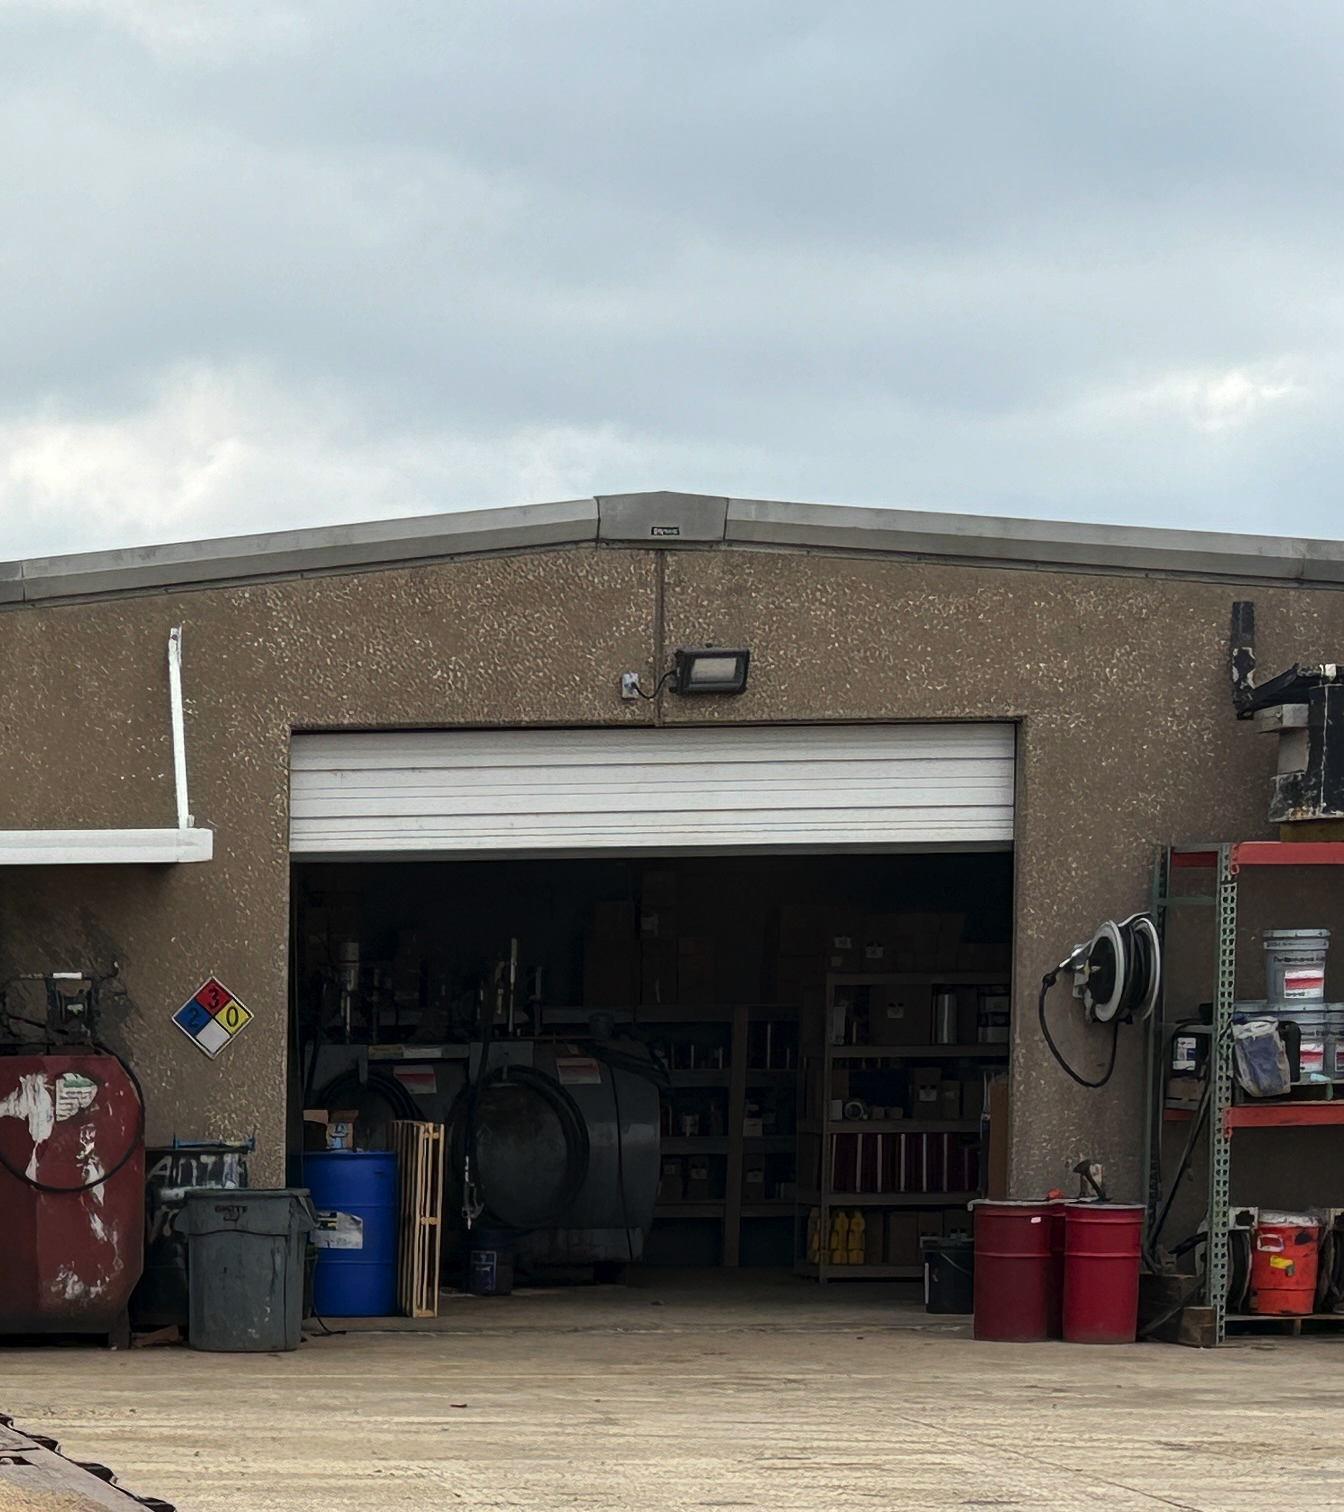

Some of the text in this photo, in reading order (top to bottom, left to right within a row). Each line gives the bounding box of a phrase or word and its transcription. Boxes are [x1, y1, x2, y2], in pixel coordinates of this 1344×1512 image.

[208, 987, 219, 1008] 3
[189, 1008, 199, 1027] 2
[226, 1006, 238, 1027] 0
